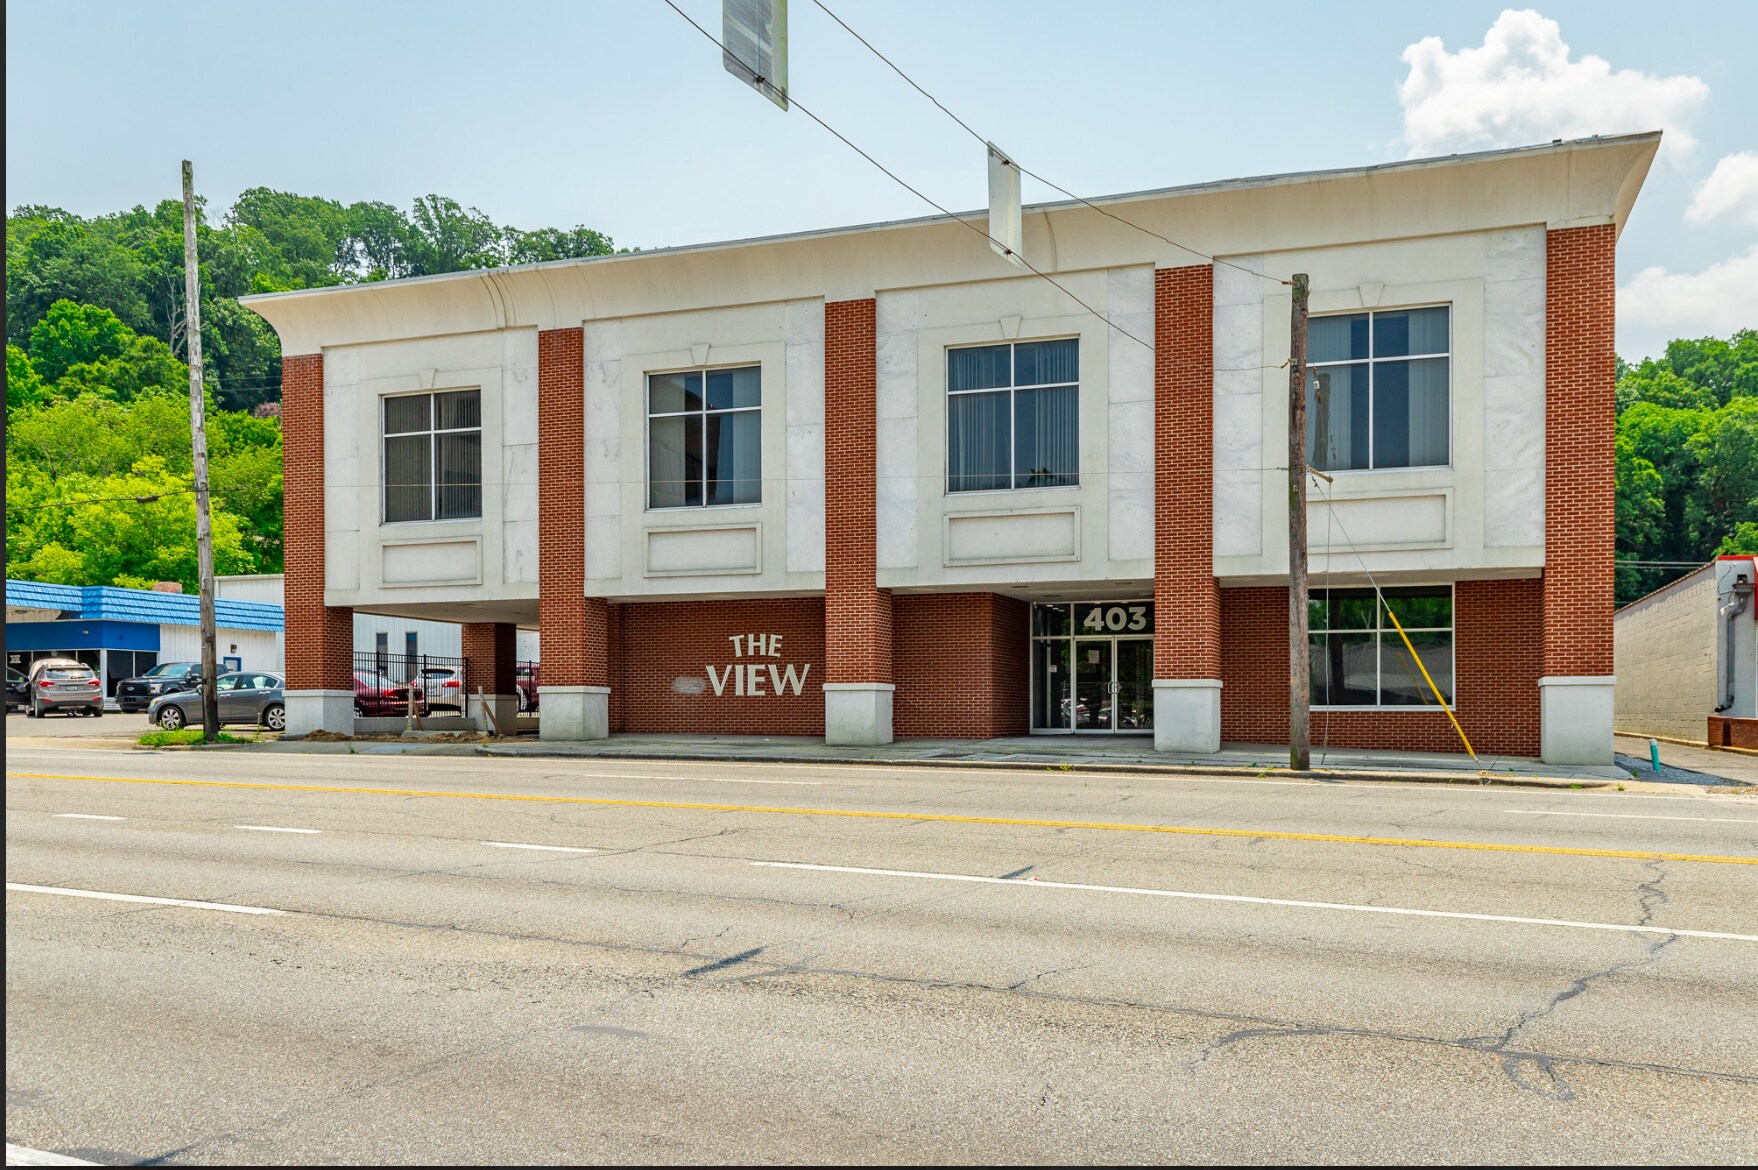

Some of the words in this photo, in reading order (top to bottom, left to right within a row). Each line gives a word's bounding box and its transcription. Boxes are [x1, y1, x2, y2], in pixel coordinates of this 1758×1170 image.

[1083, 606, 1147, 631] 403
[728, 633, 783, 658] THE
[705, 663, 811, 697] VIEW
